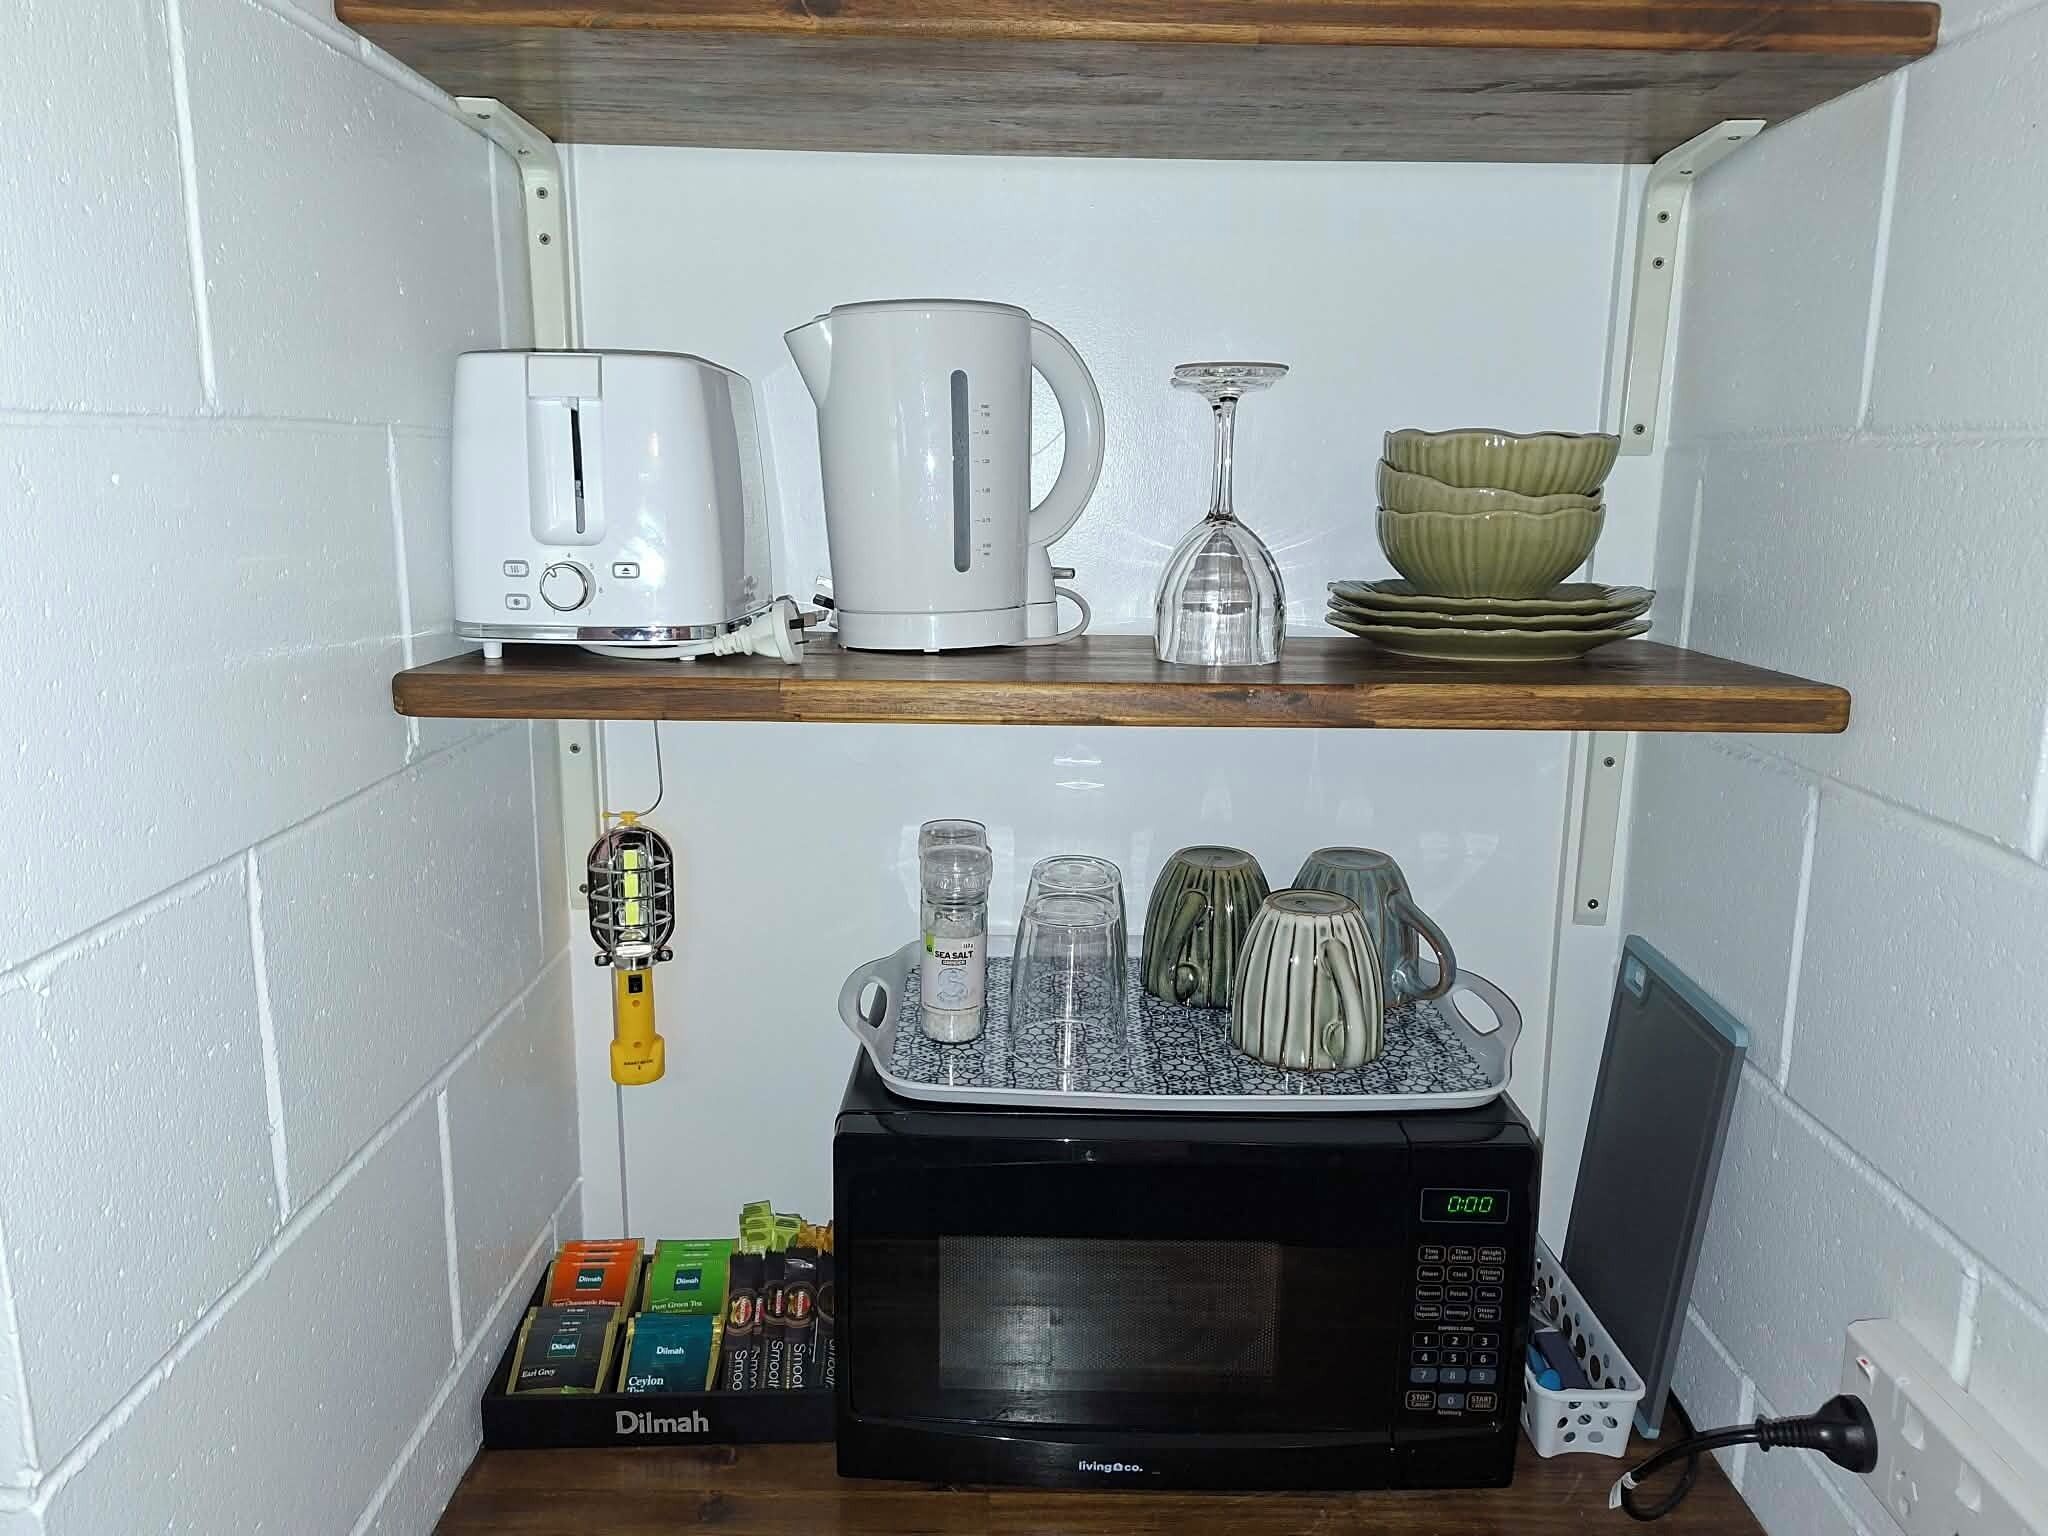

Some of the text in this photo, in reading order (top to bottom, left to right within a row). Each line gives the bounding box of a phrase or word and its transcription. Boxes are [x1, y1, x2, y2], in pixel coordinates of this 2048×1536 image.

[934, 950, 974, 960] SEA SALT
[1447, 1196, 1494, 1213] 0:00
[1422, 1335, 1429, 1345] 1
[1451, 1336, 1459, 1345] 2
[1481, 1337, 1488, 1346] 3
[551, 1342, 577, 1351] Dilmah
[656, 1345, 685, 1356] Dilmah
[1421, 1353, 1428, 1362] 4
[1450, 1353, 1457, 1362] 5
[1479, 1354, 1487, 1363] 6
[537, 1367, 556, 1377] Grey
[1419, 1370, 1427, 1380] 7
[628, 1374, 664, 1388] Ceylon
[615, 1409, 709, 1435] Dilmah
[1078, 1460, 1113, 1473] living
